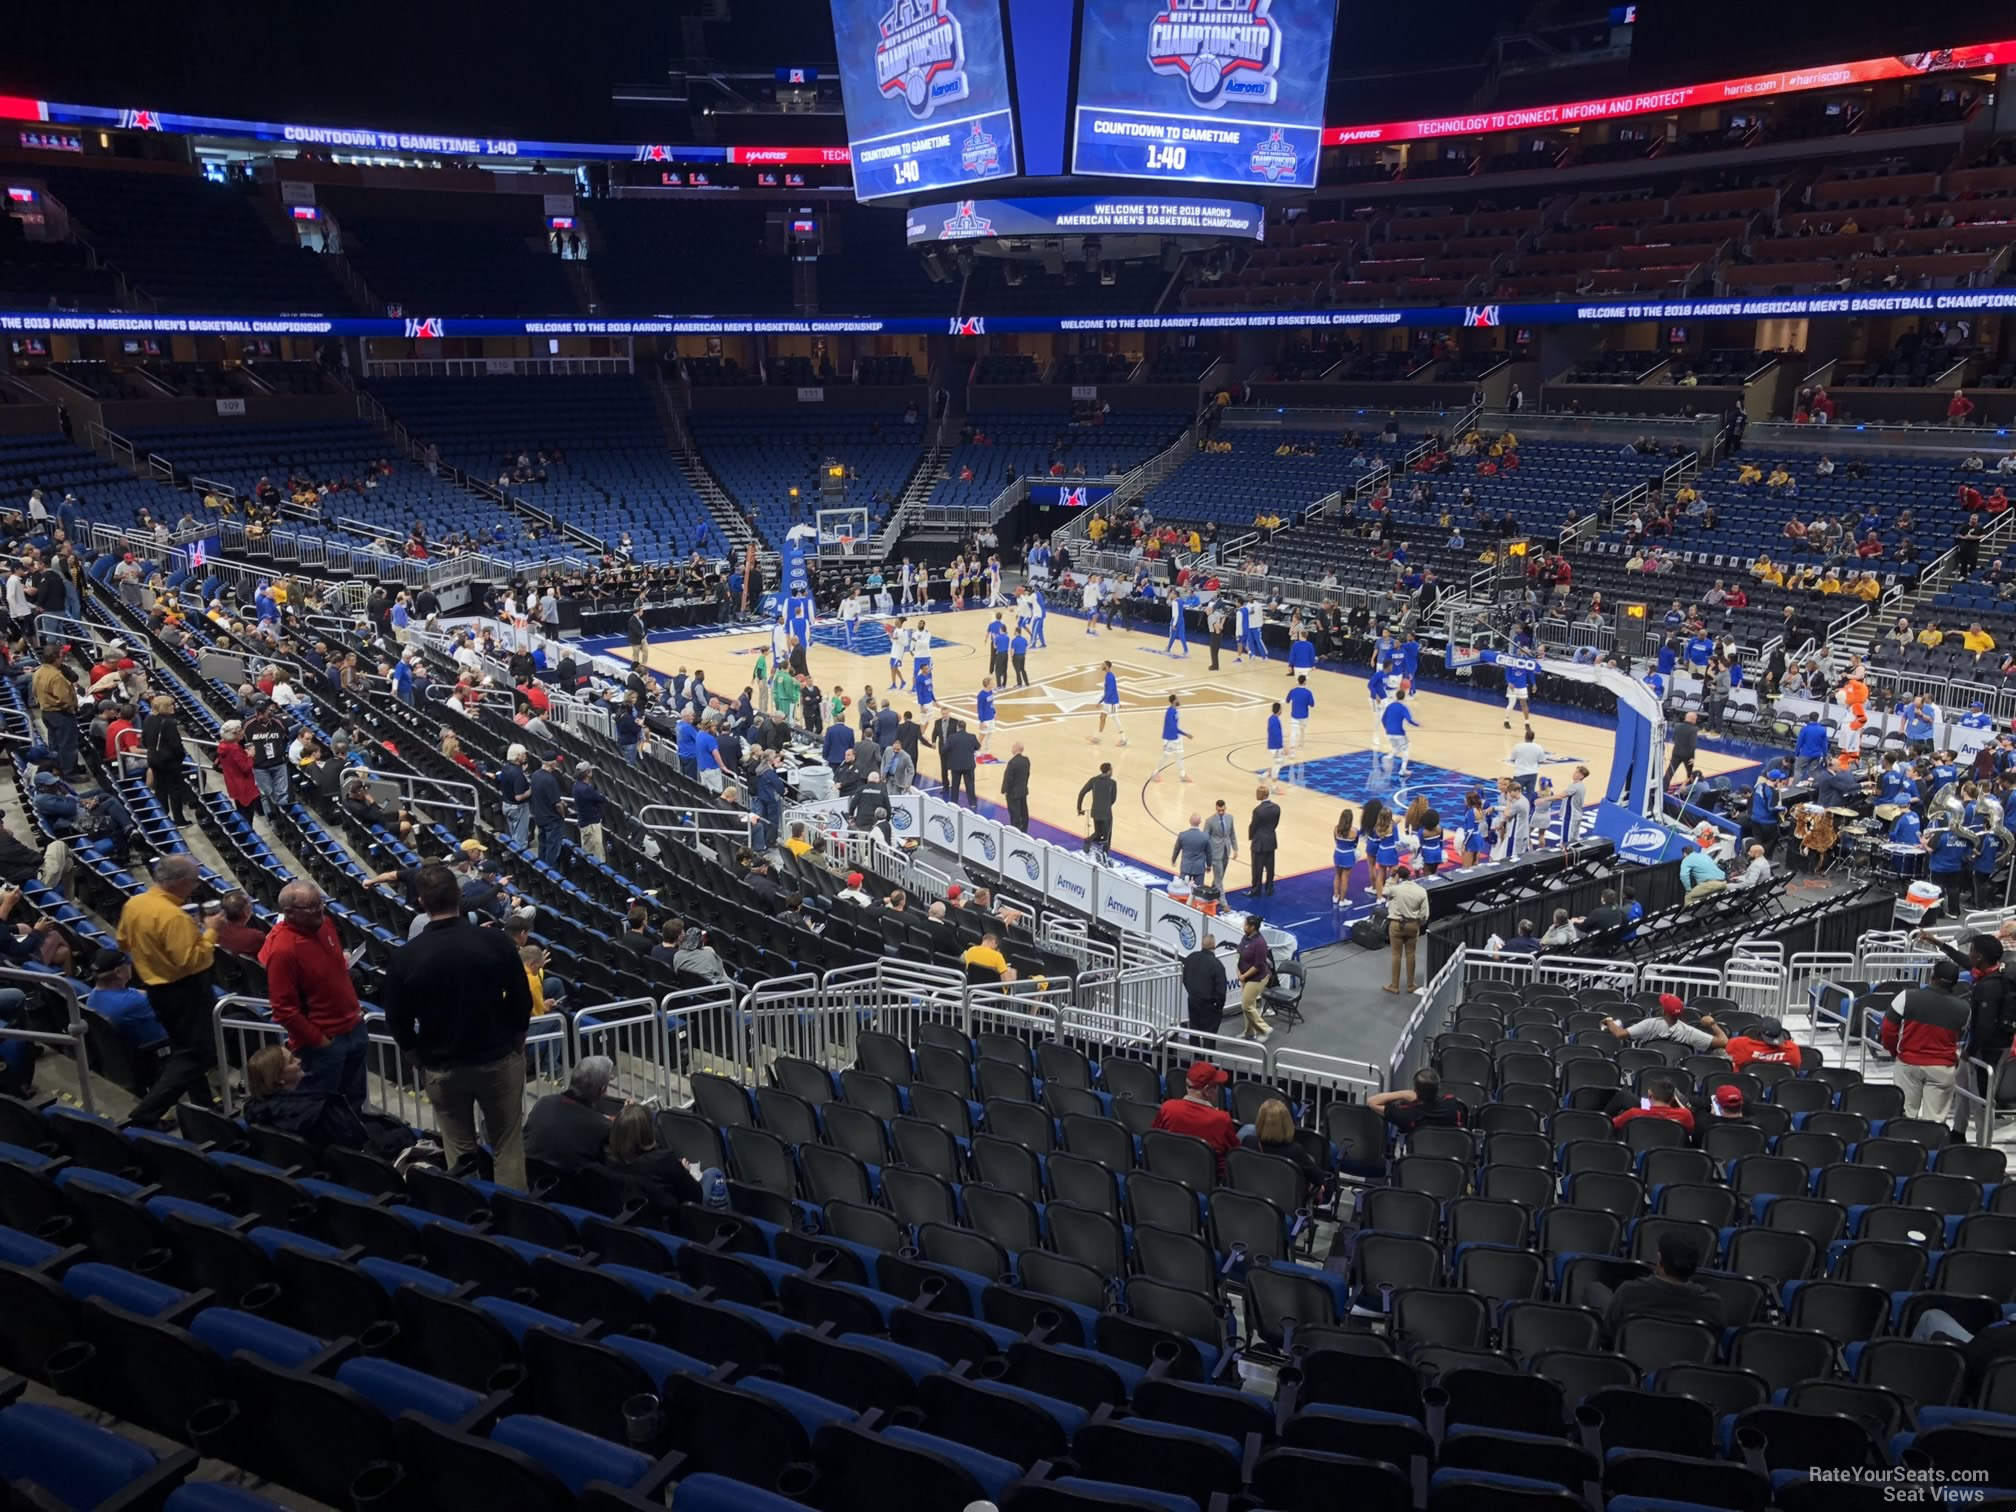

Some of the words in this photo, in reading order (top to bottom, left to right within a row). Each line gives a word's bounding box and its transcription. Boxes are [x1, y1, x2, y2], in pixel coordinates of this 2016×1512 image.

[1169, 12, 1197, 23] MEN'S
[1199, 12, 1254, 24] BASKETBALL
[1151, 24, 1270, 61] CHAMPIONSHIP
[878, 23, 953, 85] CHAMPIONSHIP
[931, 79, 959, 97] Aaron's
[1225, 79, 1267, 93] Aaron's
[1724, 80, 1777, 96] harris.com
[1789, 69, 1850, 86] #harriscorp
[1093, 120, 1164, 139] COUNTDOWN
[1166, 127, 1180, 139] TO
[1182, 127, 1240, 144] GAMETIME
[1339, 129, 1383, 144] HARRIS
[1417, 117, 1489, 135] TECHNOLOGY
[1491, 116, 1505, 127] TO
[1507, 108, 1559, 126] CONNECT,
[1562, 104, 1606, 120] INFORM
[1608, 100, 1633, 113] AND
[284, 126, 377, 147] COUNTDOWN
[379, 134, 397, 147] TO
[400, 136, 481, 153] GAMETIME:
[486, 140, 518, 155] 1:40
[860, 145, 901, 164] COUNTDOWN
[902, 142, 911, 154] TO
[911, 134, 951, 153] GAMETIME
[745, 151, 788, 164] HARRIS
[1146, 144, 1187, 170] 1:40
[894, 159, 920, 185] 1:40
[1094, 205, 1144, 215] WELCOME
[1146, 205, 1159, 215] TO
[1160, 205, 1177, 215] THE
[1179, 206, 1200, 216] 2018
[1202, 207, 1231, 217] AARON'S
[1056, 215, 1111, 225] AMERICAN
[1113, 215, 1145, 225] MEN'S
[1147, 216, 1201, 227] BASKETBALL
[1202, 218, 1249, 230] CHAMPIONSHIP
[1577, 307, 1626, 319] WELCOME
[1628, 306, 1641, 318] TO
[1643, 306, 1662, 317] THE
[1664, 305, 1692, 316] 2018
[1693, 303, 1741, 316] AARON'S
[1742, 301, 1807, 314] AMERICAN
[1809, 299, 1849, 312] MEN'S
[1851, 297, 1934, 311] BASKETBALL
[1936, 294, 2016, 309] CHAMPION
[0, 317, 22, 329] THE
[23, 317, 51, 329] 2018
[52, 318, 96, 330] AARON'S
[97, 318, 153, 330] AMERICAN
[154, 319, 186, 331] MEN'S
[188, 320, 252, 332] BASKETBALL
[252, 321, 332, 333] CHAMPIONSHIP
[525, 322, 572, 333] WELCOME
[573, 322, 586, 332] TO
[587, 322, 606, 332] THE
[607, 322, 631, 332] 2018
[632, 322, 672, 332] AARON'S
[673, 322, 722, 332] AMERICAN
[724, 322, 753, 332] MEN'S
[754, 322, 810, 332] BASKETBALL
[811, 322, 883, 332] CHAMPIONSHIP
[1061, 319, 1104, 330] WELCOME
[1105, 319, 1117, 329] TO
[1118, 319, 1135, 328] THE
[1137, 318, 1160, 328] 2018
[1161, 317, 1198, 328] AARON'S
[1199, 316, 1247, 327] AMERICAN
[1248, 315, 1275, 326] MEN'S
[1276, 315, 1331, 326] BASKETBALL
[1332, 313, 1401, 325] CHAMPIONSHIP
[223, 401, 240, 410] 109
[1495, 654, 1536, 671] GEICO
[1620, 831, 1662, 849] LIBMAN
[1057, 874, 1086, 899] Amway
[1107, 895, 1139, 922] Amway
